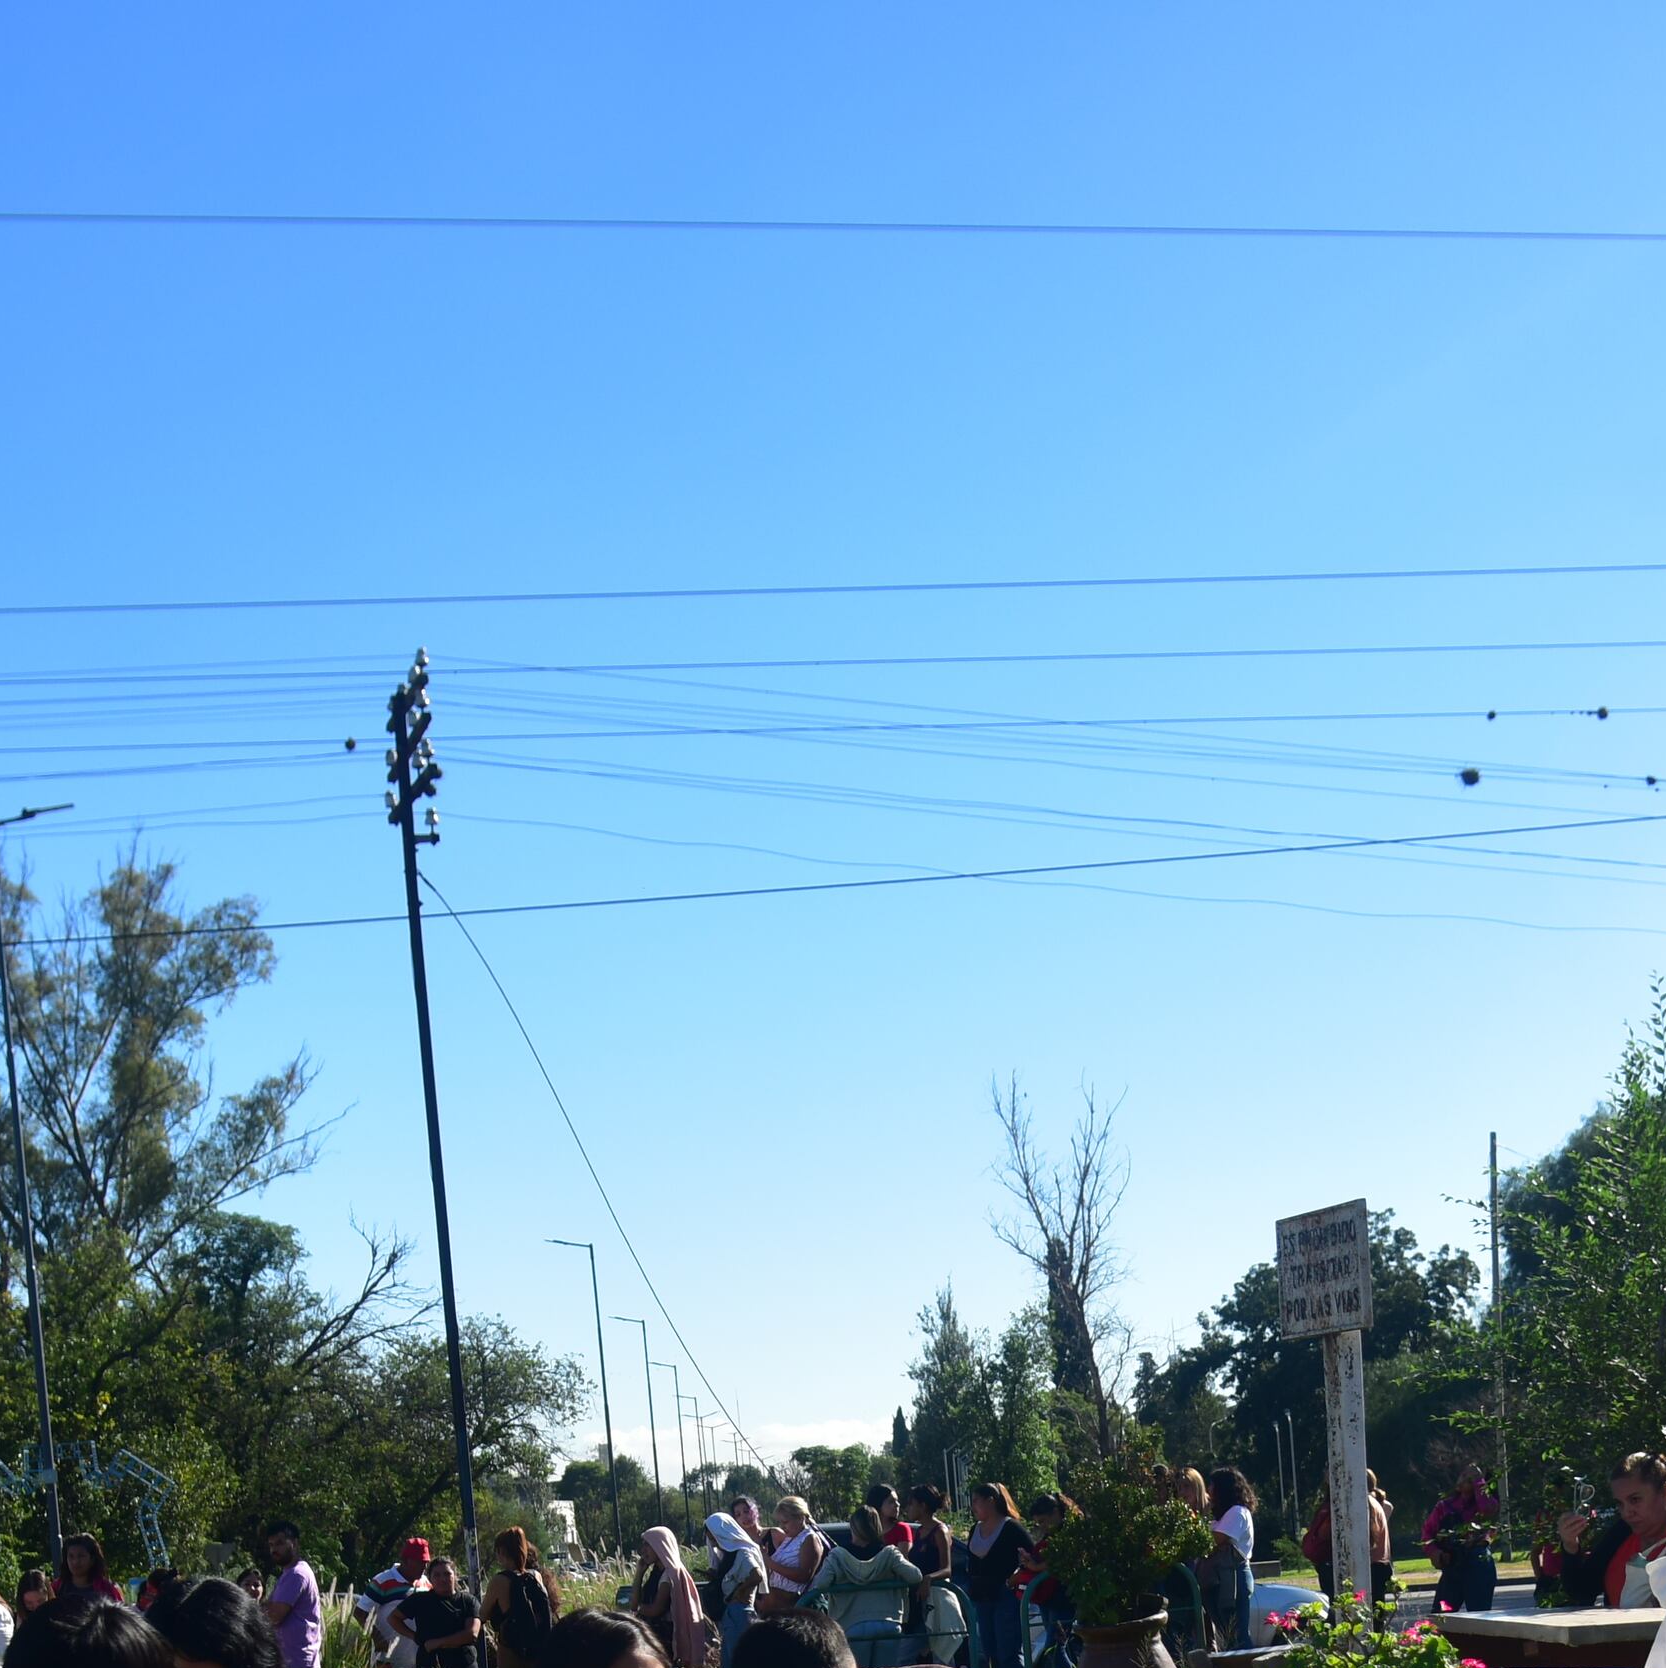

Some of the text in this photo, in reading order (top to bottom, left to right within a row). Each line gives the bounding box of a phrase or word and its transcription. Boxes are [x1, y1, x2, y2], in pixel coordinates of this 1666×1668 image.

[1282, 1219, 1357, 1257] ES PROHIBIDO
[1289, 1254, 1350, 1289] TRANSITAR
[1285, 1297, 1307, 1323] POR
[1310, 1292, 1333, 1320] LAS
